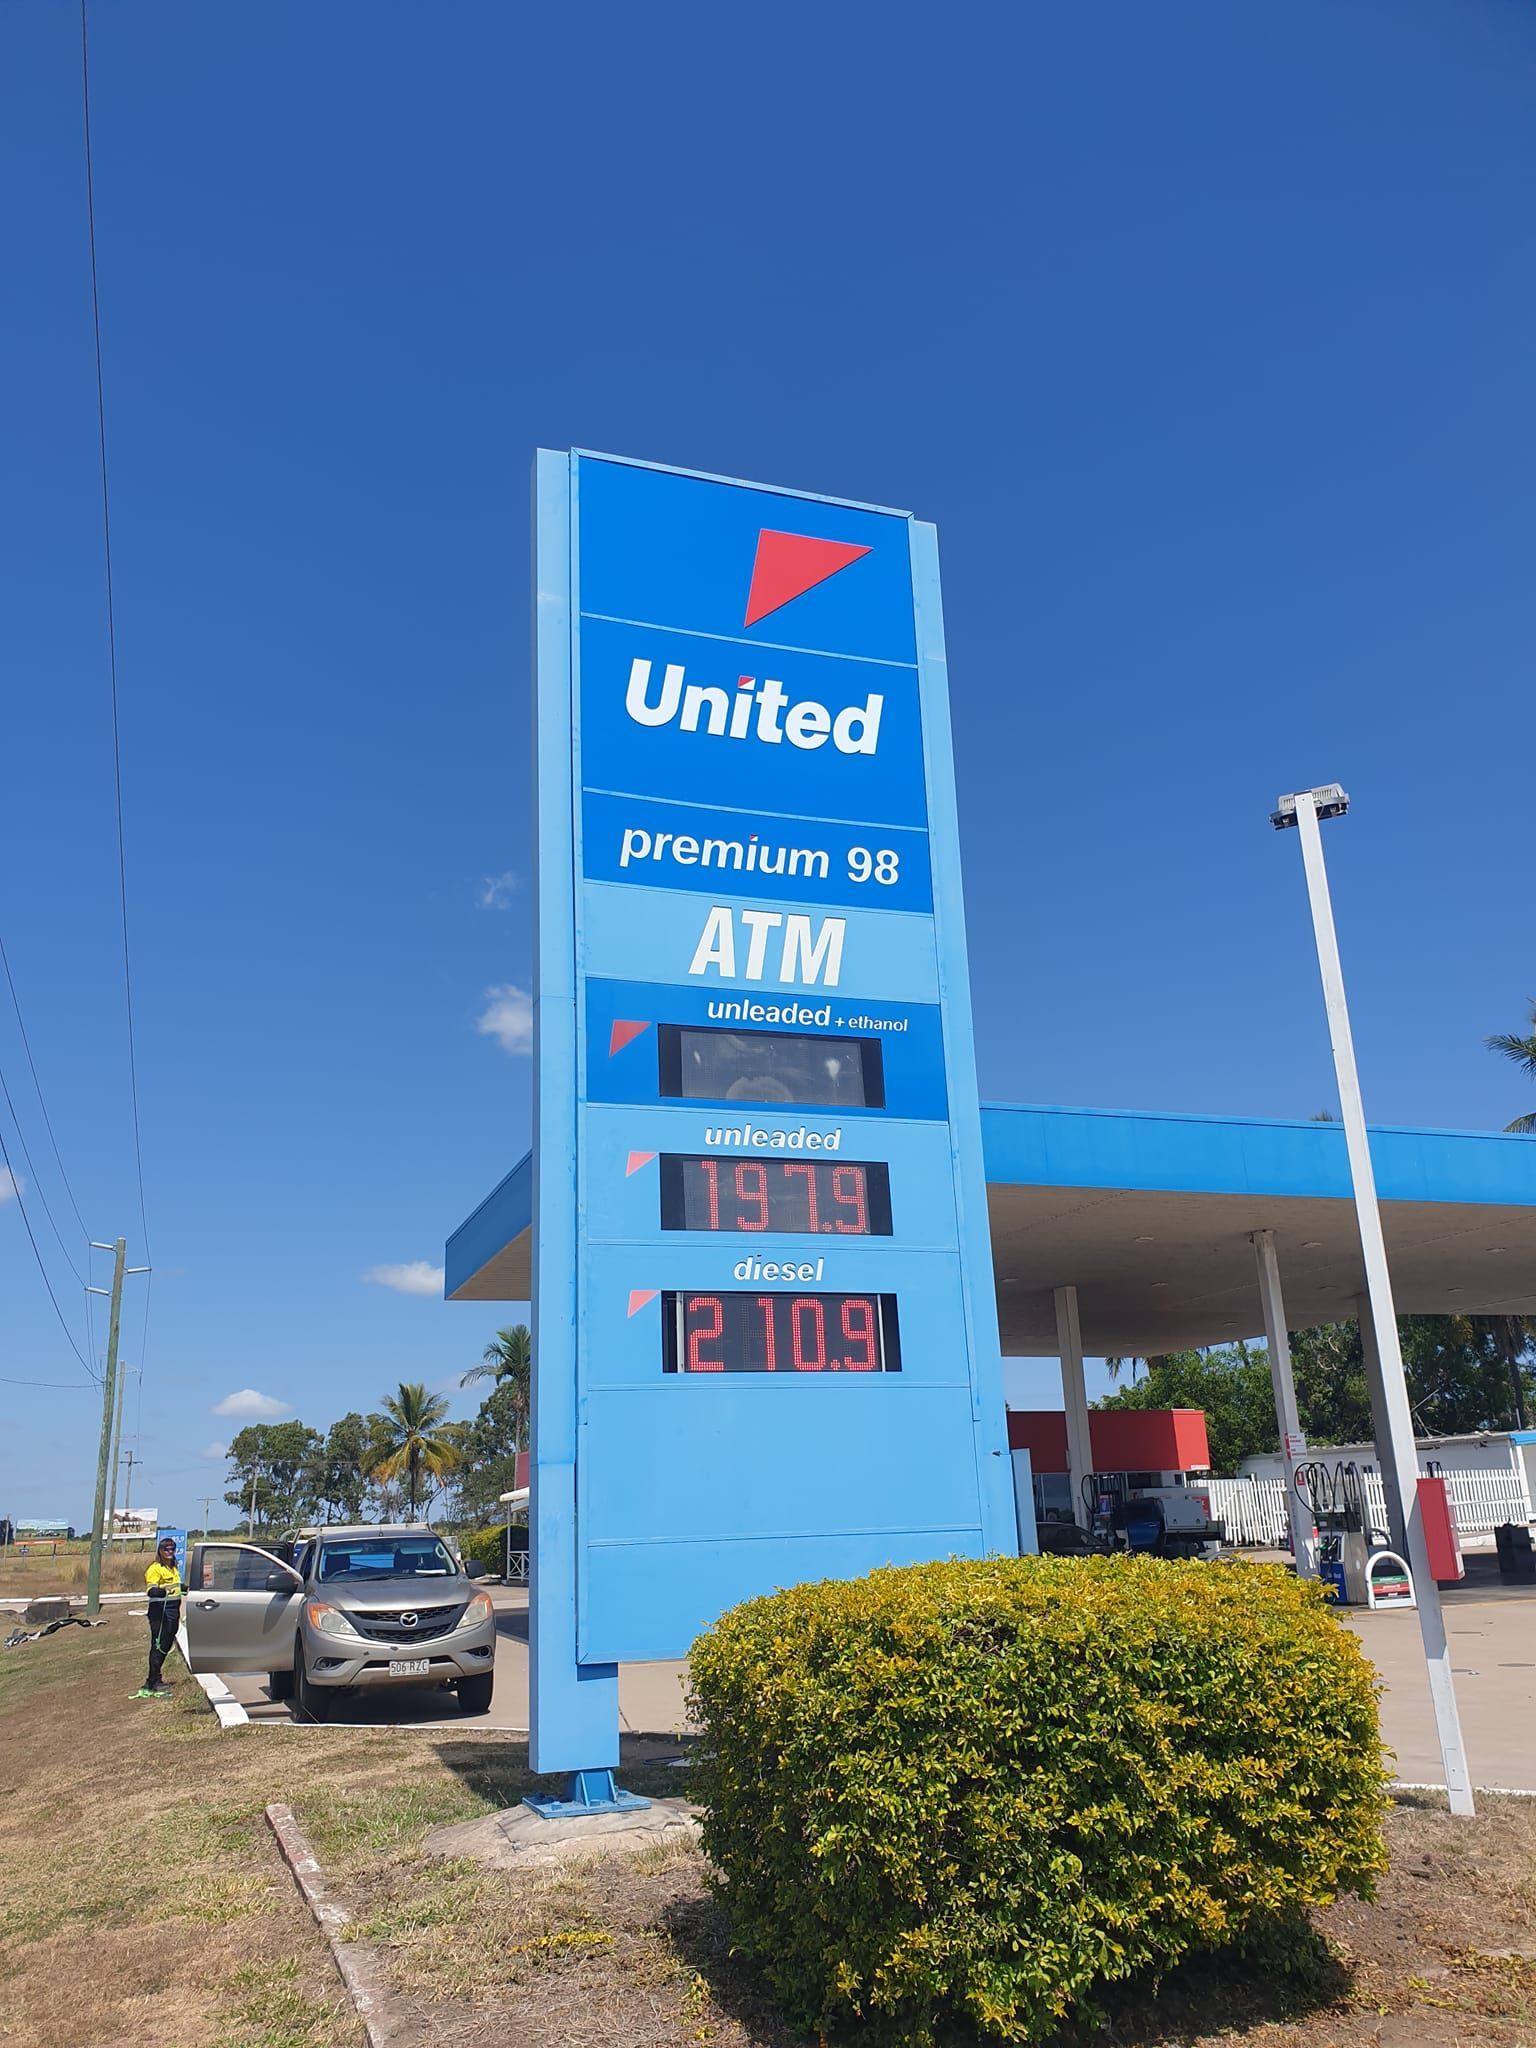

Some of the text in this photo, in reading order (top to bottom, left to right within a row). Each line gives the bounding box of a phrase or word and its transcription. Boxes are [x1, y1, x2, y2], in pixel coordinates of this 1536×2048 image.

[625, 657, 884, 755] United
[619, 828, 900, 886] premium 98
[688, 905, 847, 987] ATM
[707, 999, 831, 1027] unleaded
[848, 1015, 908, 1032] ethanol
[704, 1123, 842, 1151] unleaded
[701, 1160, 867, 1234] 197.9
[733, 1255, 825, 1282] diesel
[688, 1296, 877, 1373] 210.9
[409, 1661, 428, 1672] RZC
